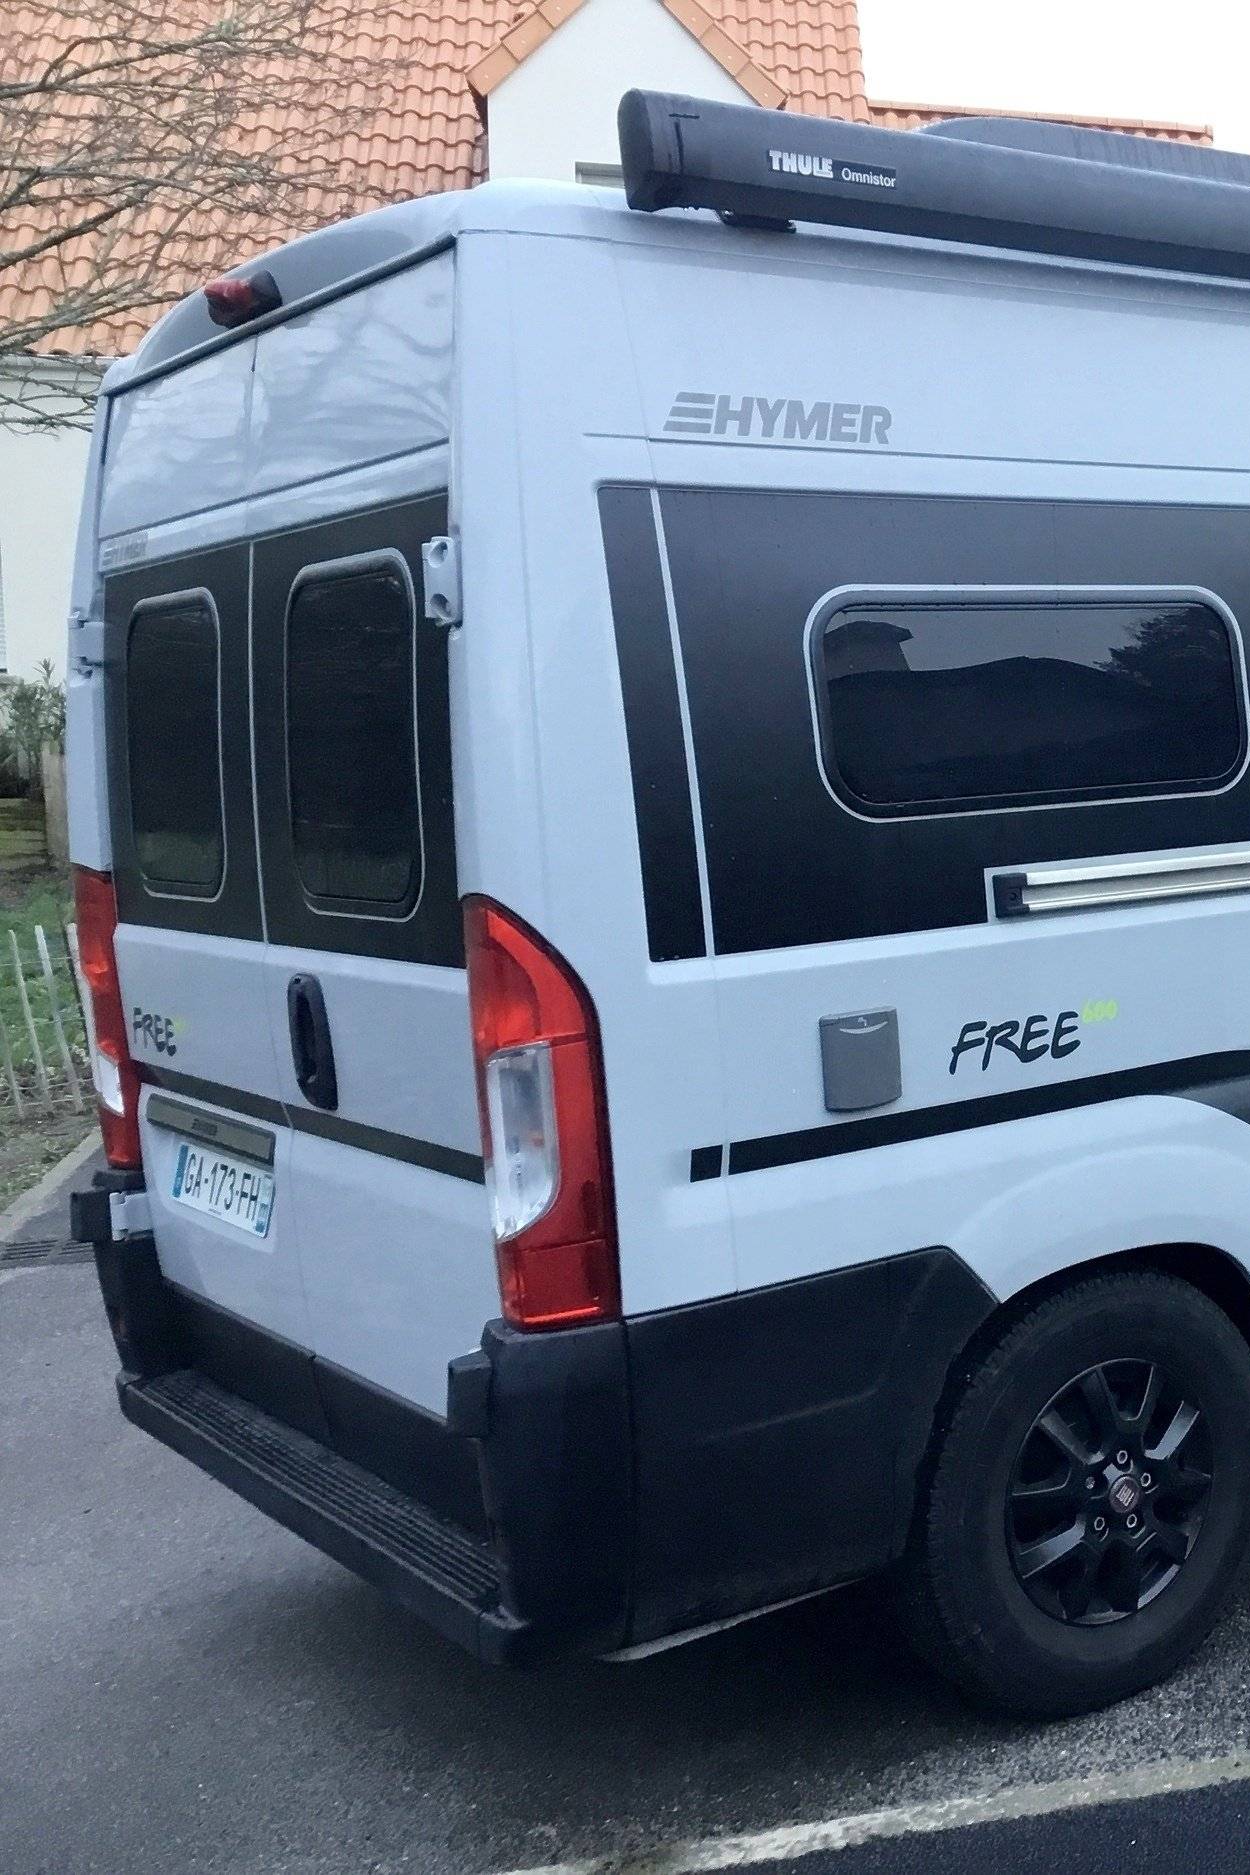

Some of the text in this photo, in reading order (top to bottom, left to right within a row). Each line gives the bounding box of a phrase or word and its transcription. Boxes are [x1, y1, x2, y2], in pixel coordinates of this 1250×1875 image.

[769, 150, 897, 188] THULE Omnistor
[713, 394, 892, 445] HYMER
[133, 1007, 177, 1057] FREE
[949, 1011, 1081, 1075] FREE
[184, 1153, 260, 1219] GA-173-FH
